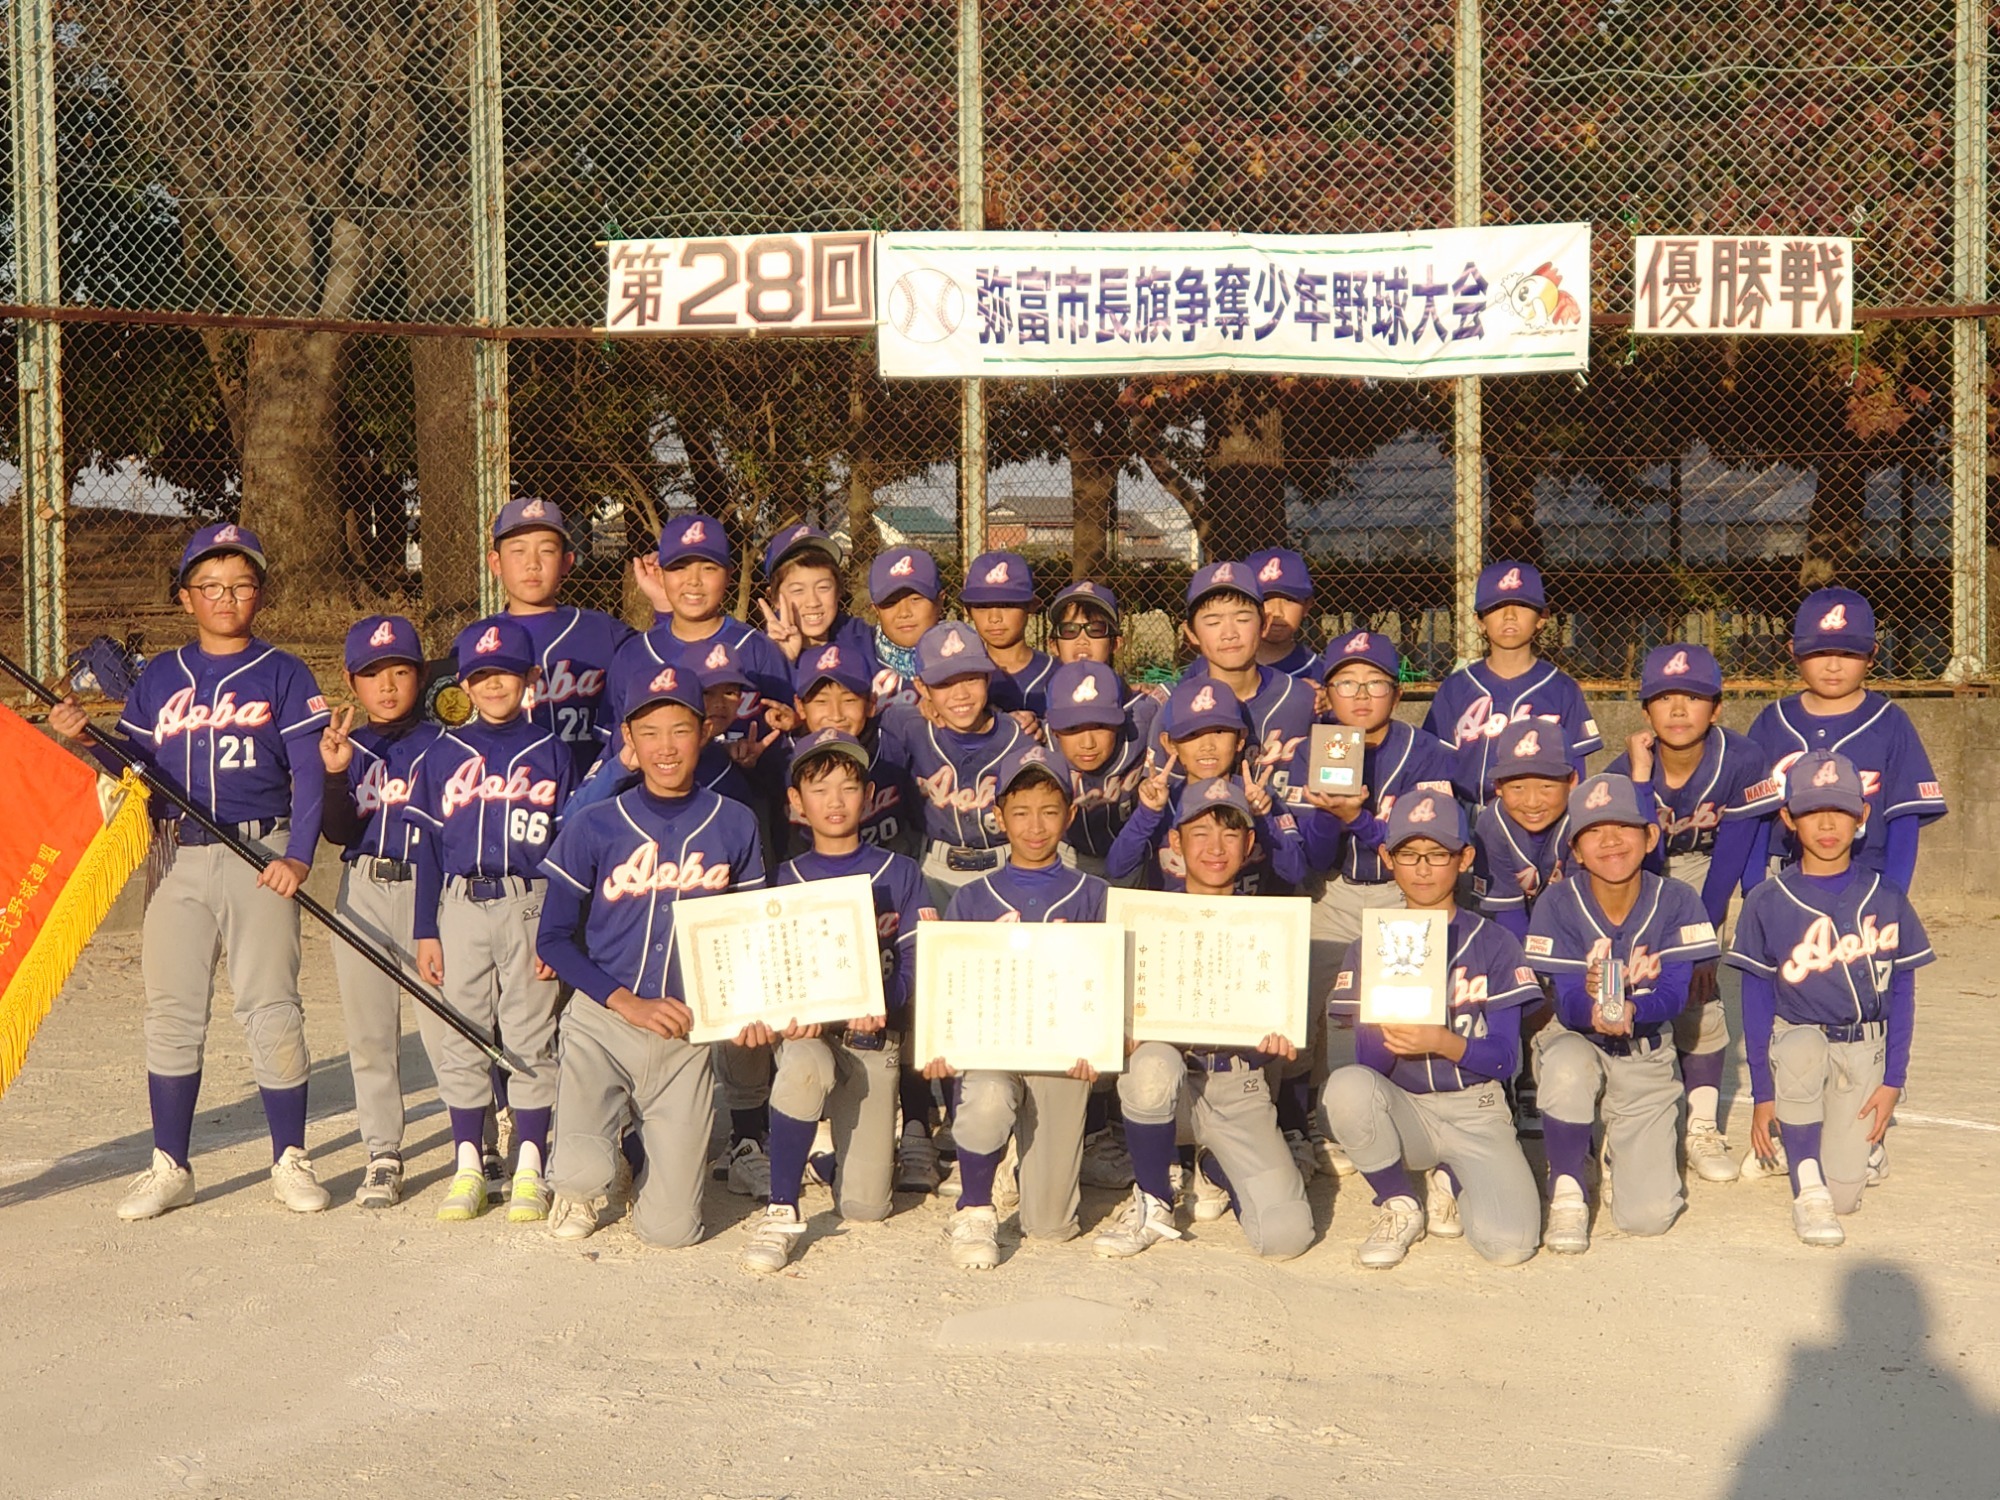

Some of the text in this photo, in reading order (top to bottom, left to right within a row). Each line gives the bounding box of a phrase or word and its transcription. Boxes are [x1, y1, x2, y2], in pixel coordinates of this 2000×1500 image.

[610, 233, 874, 327] 第28回
[1640, 238, 1843, 331] 優勝戦
[976, 262, 1489, 345] 弥富市長旗争奪少年野球大会
[521, 497, 546, 519] A
[213, 524, 240, 544] A
[680, 521, 708, 545] A
[889, 555, 915, 577] A
[984, 561, 1009, 585] A
[1210, 562, 1234, 584] A
[1258, 557, 1283, 583] A
[1497, 567, 1523, 591] A
[1819, 604, 1848, 631] A
[369, 621, 396, 648] A
[475, 626, 502, 654] A
[940, 629, 966, 657] A
[1343, 632, 1370, 654] A
[704, 643, 729, 670] A
[816, 646, 842, 671] A
[1662, 650, 1690, 676] A
[649, 668, 678, 693] A
[1071, 675, 1099, 704] A
[1190, 685, 1217, 713] A
[154, 686, 272, 745] Aoba
[219, 735, 257, 769] 21
[1513, 730, 1541, 758] A
[441, 755, 557, 818] Aoba
[1812, 760, 1839, 787] A
[1204, 778, 1231, 801] A
[1584, 781, 1612, 810] A
[1408, 797, 1436, 823] A
[510, 807, 550, 845] 66
[602, 840, 732, 902] Aoba
[834, 932, 852, 970] 賞状
[1782, 915, 1900, 984] Aoba
[1135, 944, 1148, 1010] 中日新聞社
[1255, 949, 1272, 994] 賞状
